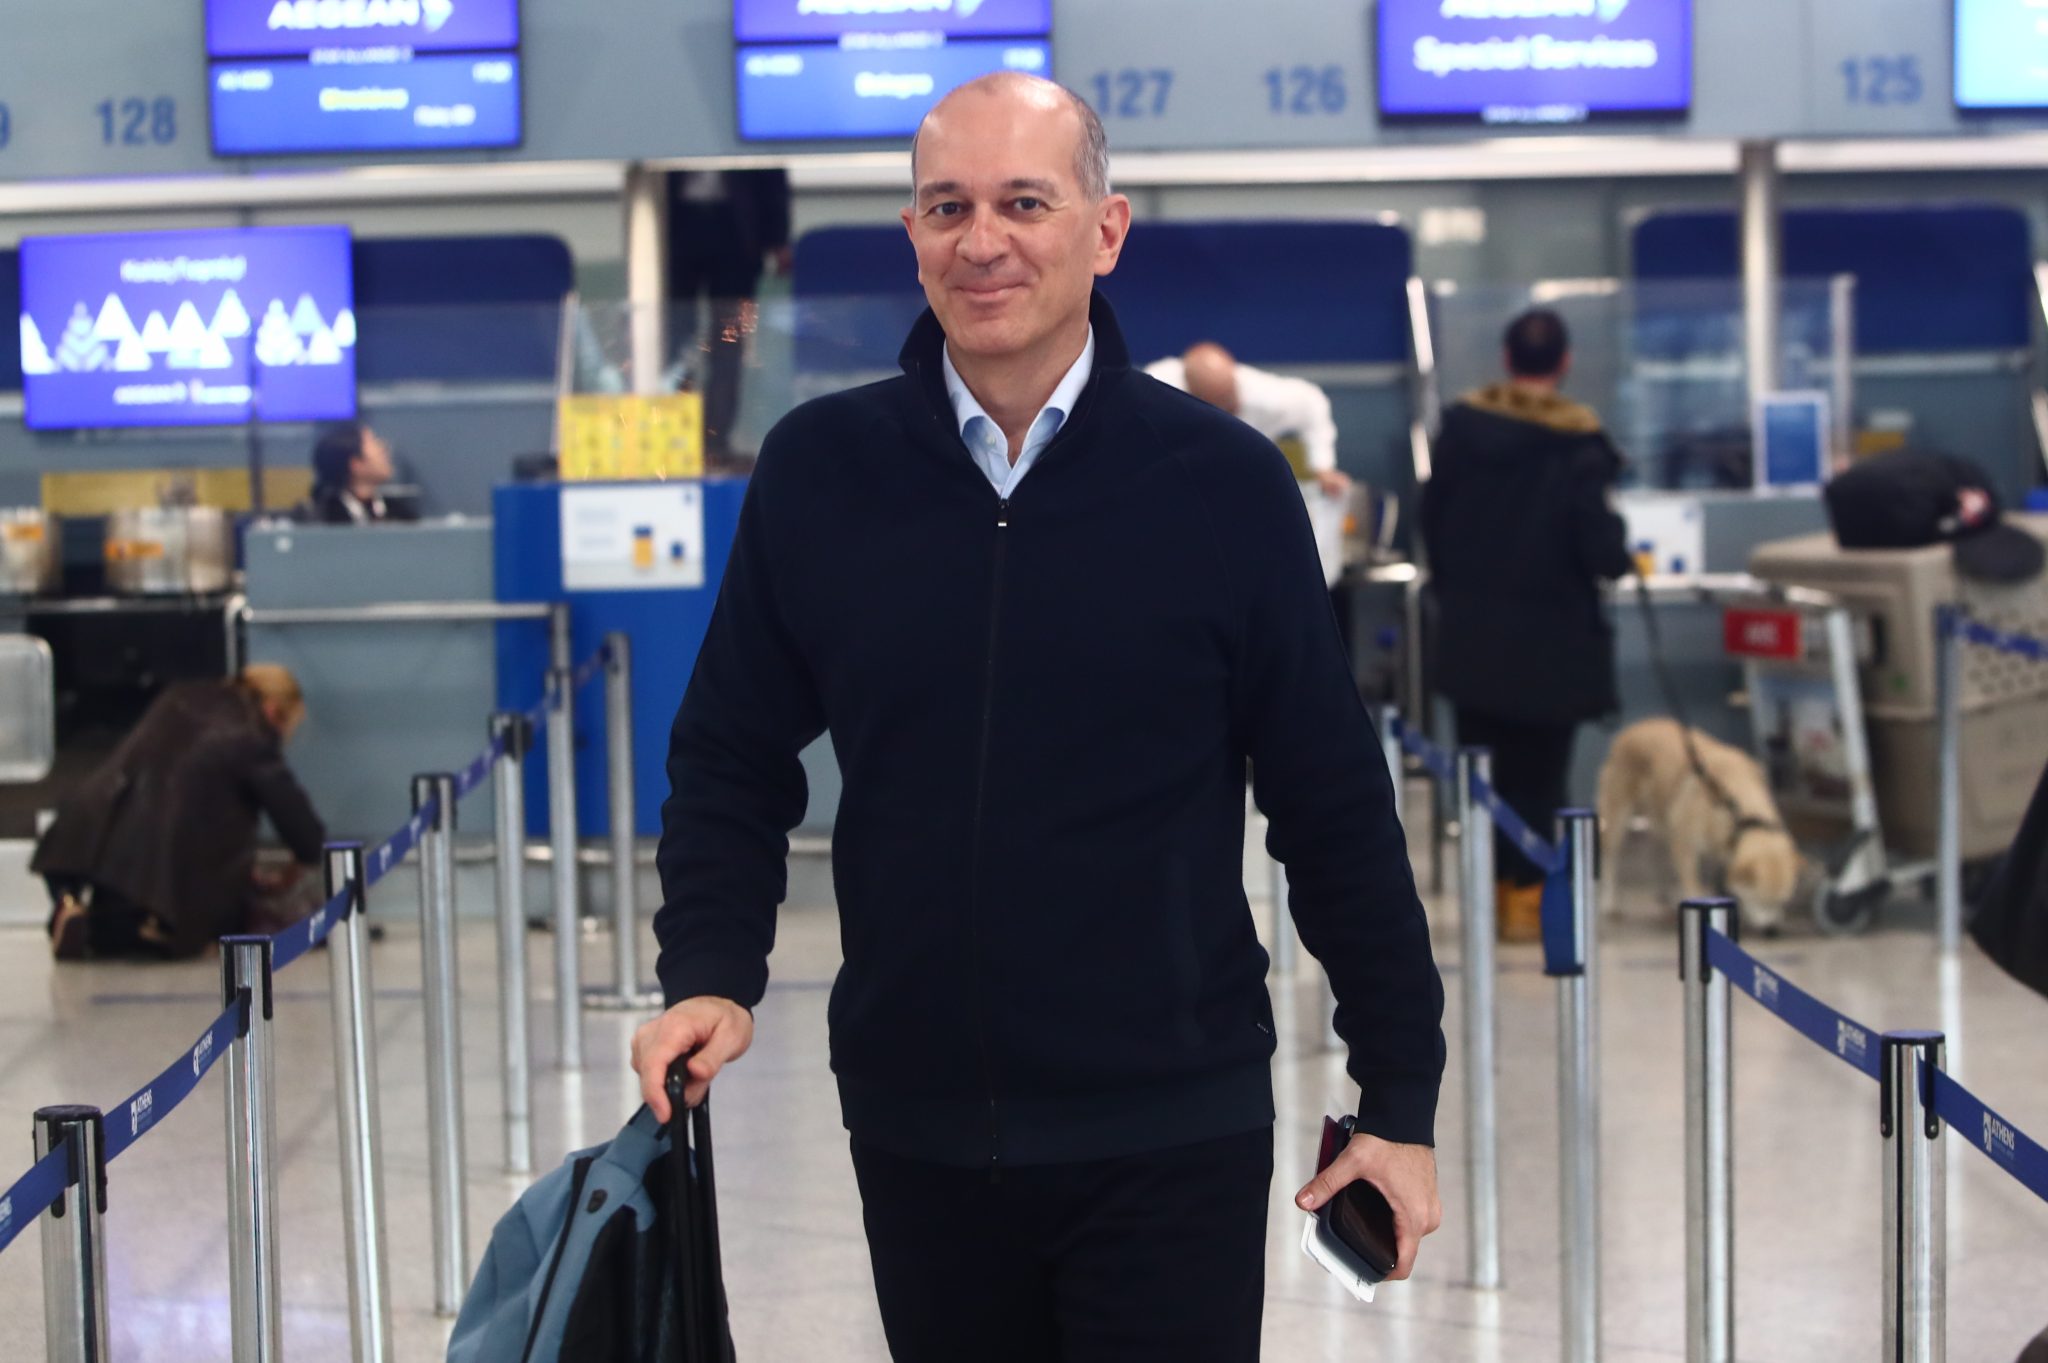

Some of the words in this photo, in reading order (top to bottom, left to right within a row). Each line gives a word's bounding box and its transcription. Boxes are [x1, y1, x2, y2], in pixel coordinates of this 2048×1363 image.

[1091, 67, 1174, 118] 127
[1263, 64, 1347, 115] 126
[1841, 54, 1924, 104] 125
[95, 96, 177, 146] 128
[1991, 1117, 2015, 1151] ATHENS
